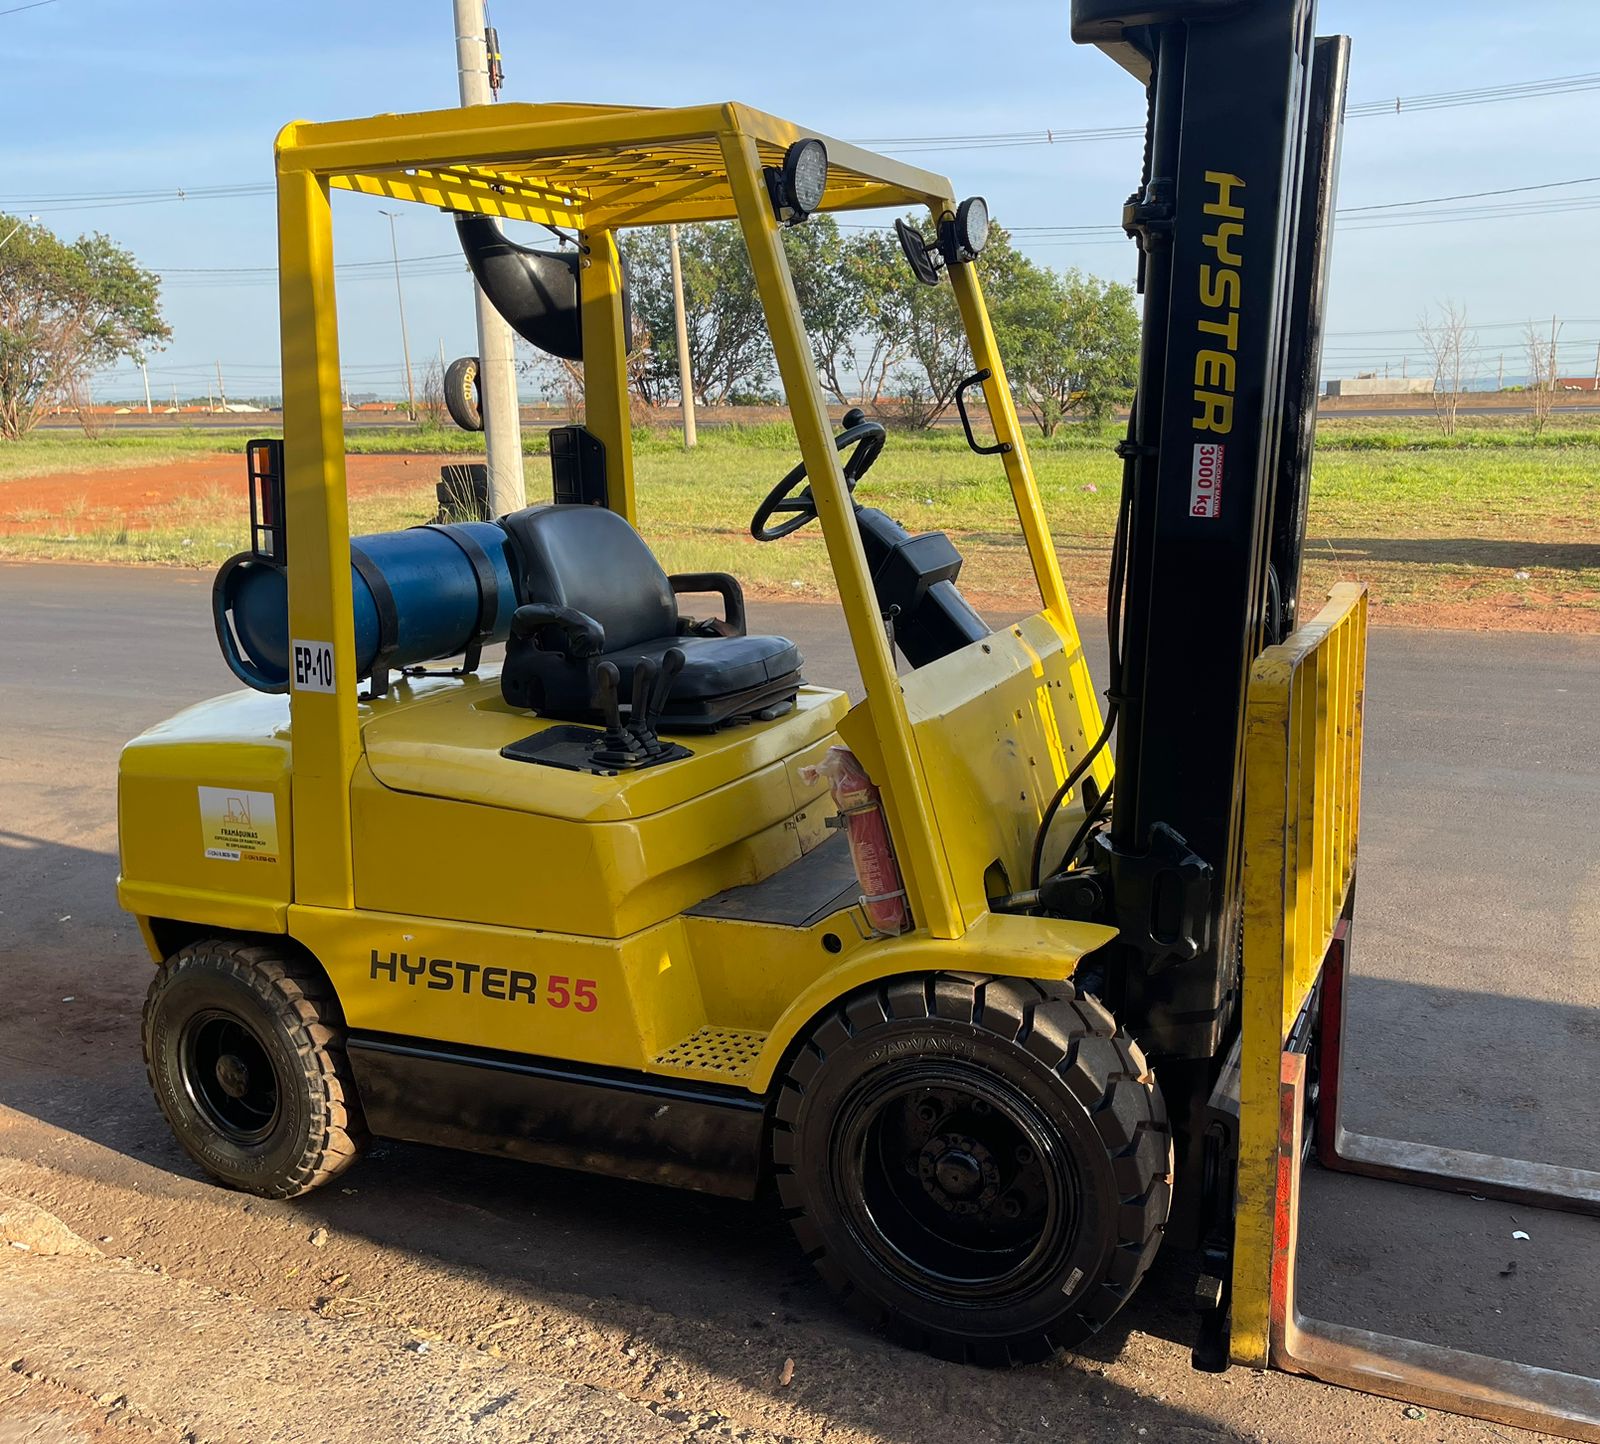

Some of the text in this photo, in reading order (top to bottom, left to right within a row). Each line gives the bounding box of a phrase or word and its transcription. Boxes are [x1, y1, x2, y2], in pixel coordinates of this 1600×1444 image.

[1192, 170, 1246, 433] HYSTER
[1192, 446, 1215, 516] 3000 kg
[1215, 446, 1224, 489] CAPACIDADE
[295, 646, 332, 686] EP-10
[370, 949, 598, 1013] HYSTER 55
